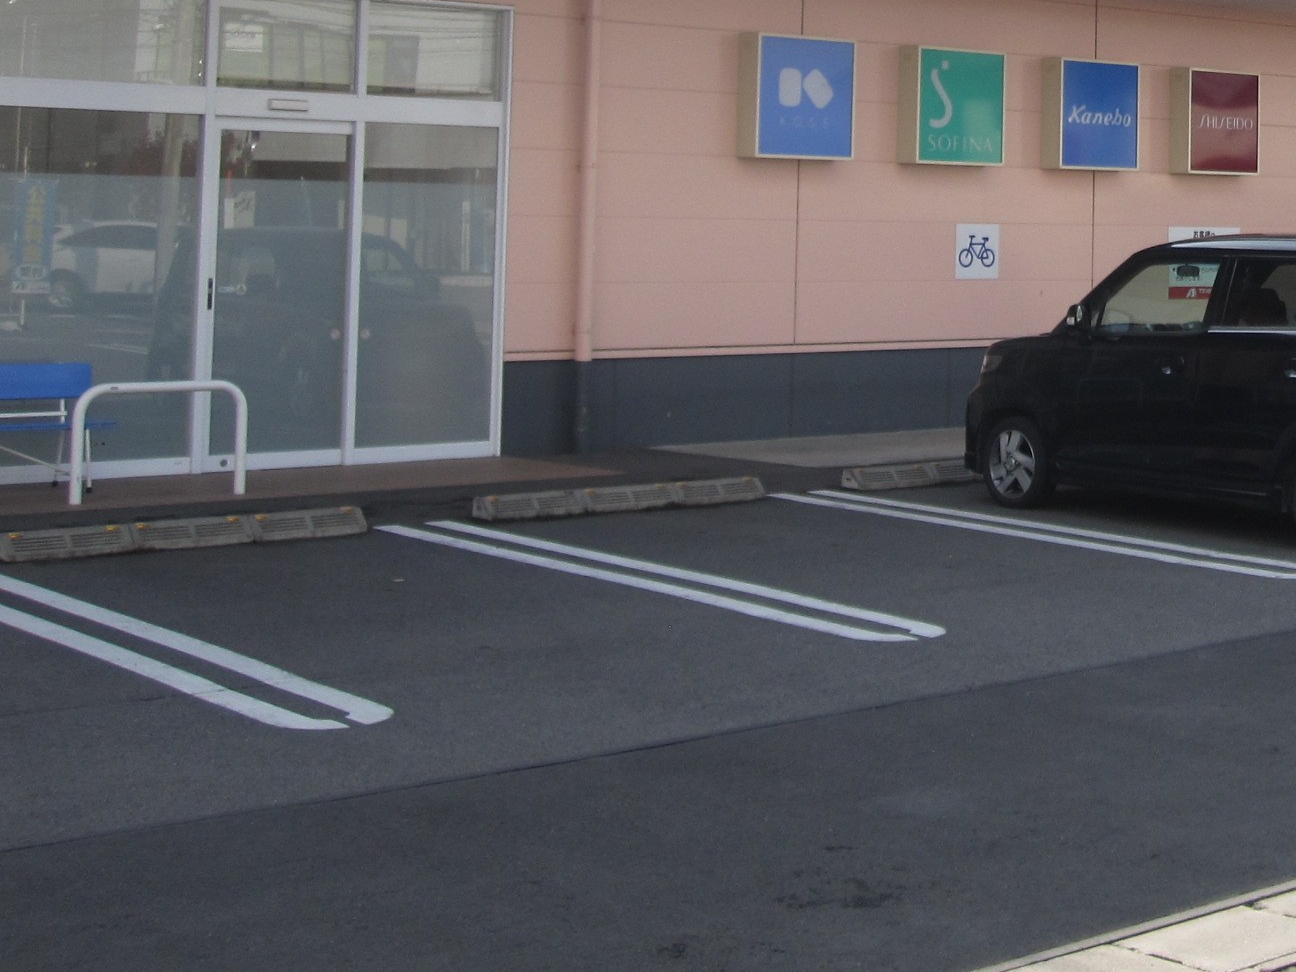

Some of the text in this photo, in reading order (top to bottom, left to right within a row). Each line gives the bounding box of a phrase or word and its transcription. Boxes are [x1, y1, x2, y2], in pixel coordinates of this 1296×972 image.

[1068, 104, 1132, 128] Kanebo
[1199, 113, 1254, 130] SHISEIDO
[928, 134, 993, 153] SOFINA
